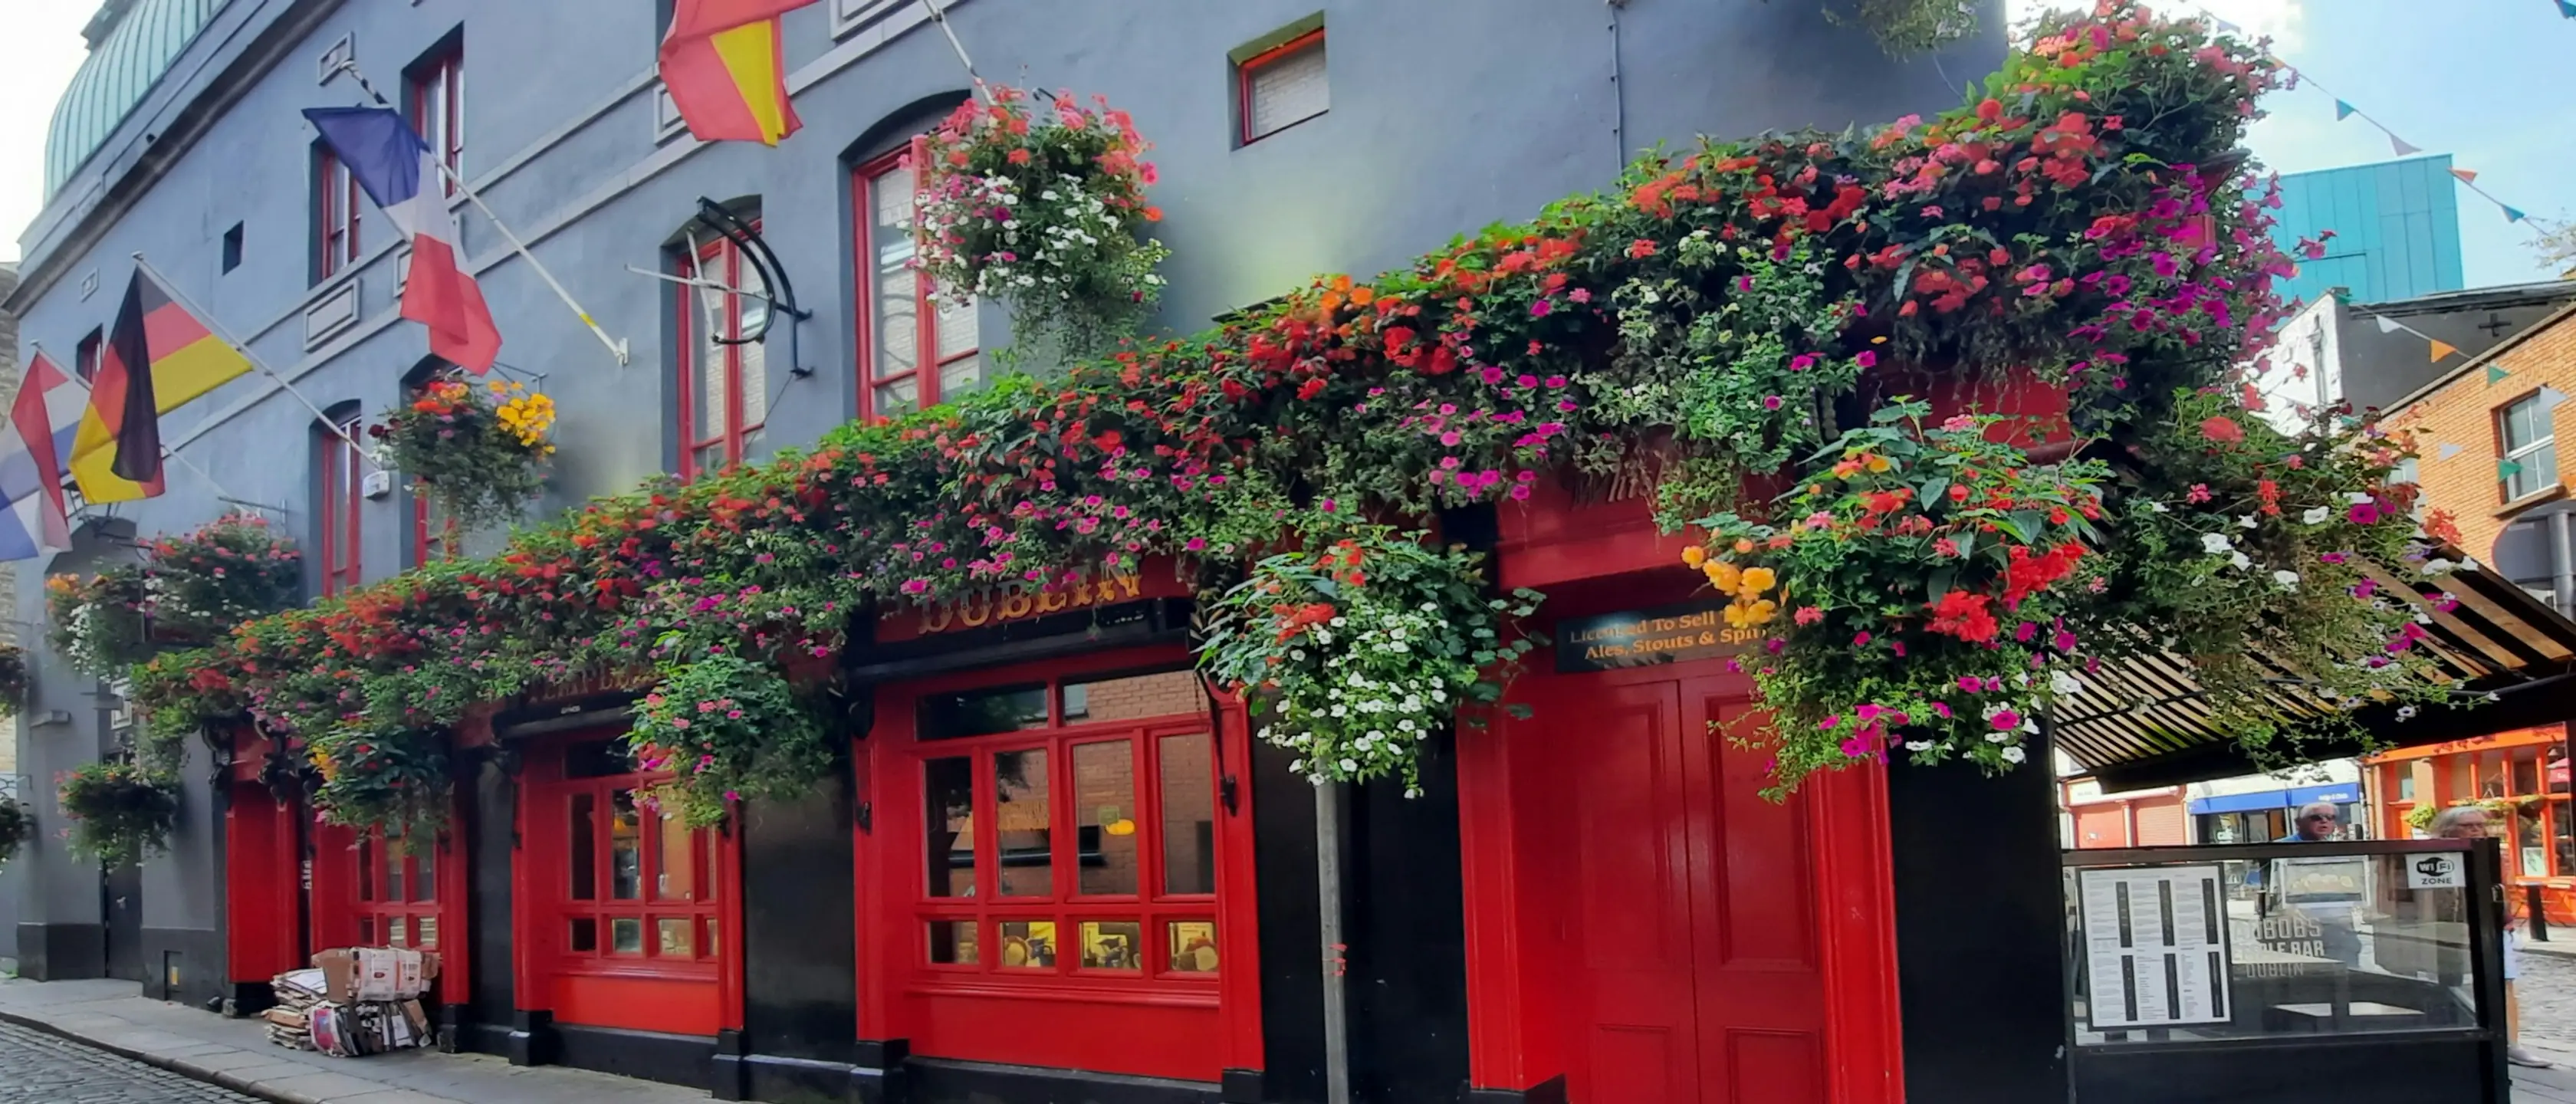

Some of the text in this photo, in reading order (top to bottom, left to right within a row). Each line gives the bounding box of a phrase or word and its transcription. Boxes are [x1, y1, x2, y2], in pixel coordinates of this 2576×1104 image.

[917, 554, 1143, 635] DUBLIN
[1569, 610, 1716, 644] Licensed To Sell
[1584, 644, 1629, 661] Ales,
[1632, 634, 1694, 653] Stouts
[1698, 630, 1717, 646] &
[2420, 877, 2453, 886] ZONE
[2290, 939, 2325, 958] BAR
[2246, 962, 2305, 978] DUBLIN
